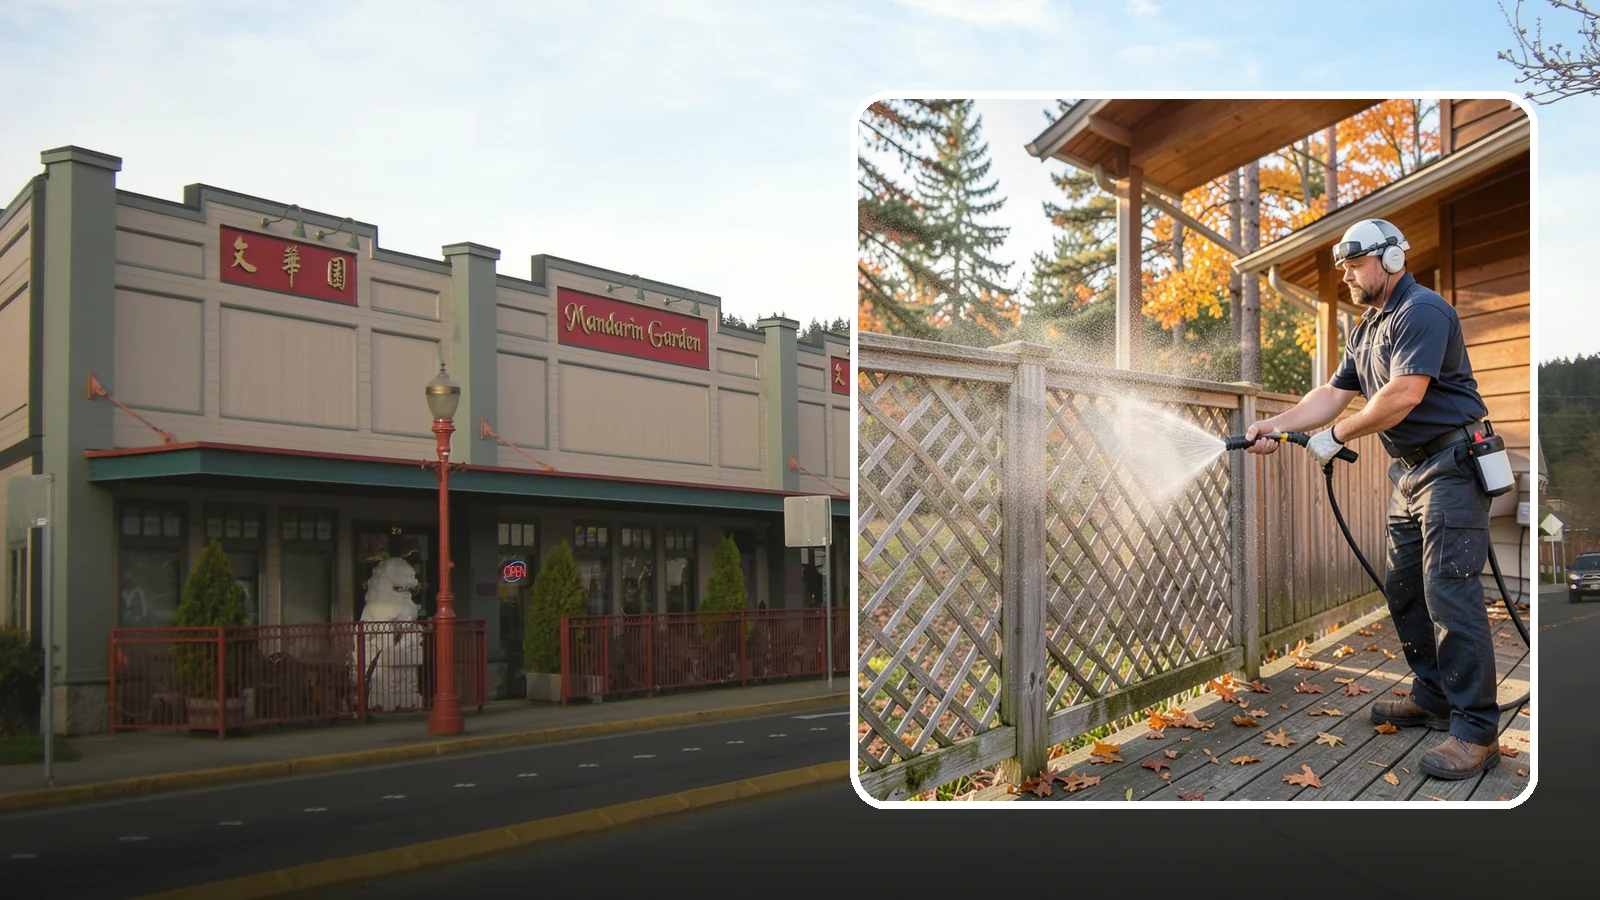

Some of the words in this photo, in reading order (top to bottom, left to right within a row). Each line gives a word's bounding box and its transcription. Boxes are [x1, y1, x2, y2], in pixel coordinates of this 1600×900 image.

[230, 235, 346, 291] 文華園
[564, 302, 644, 341] Mandarin
[647, 320, 701, 352] Garden
[503, 565, 527, 578] OPEN
